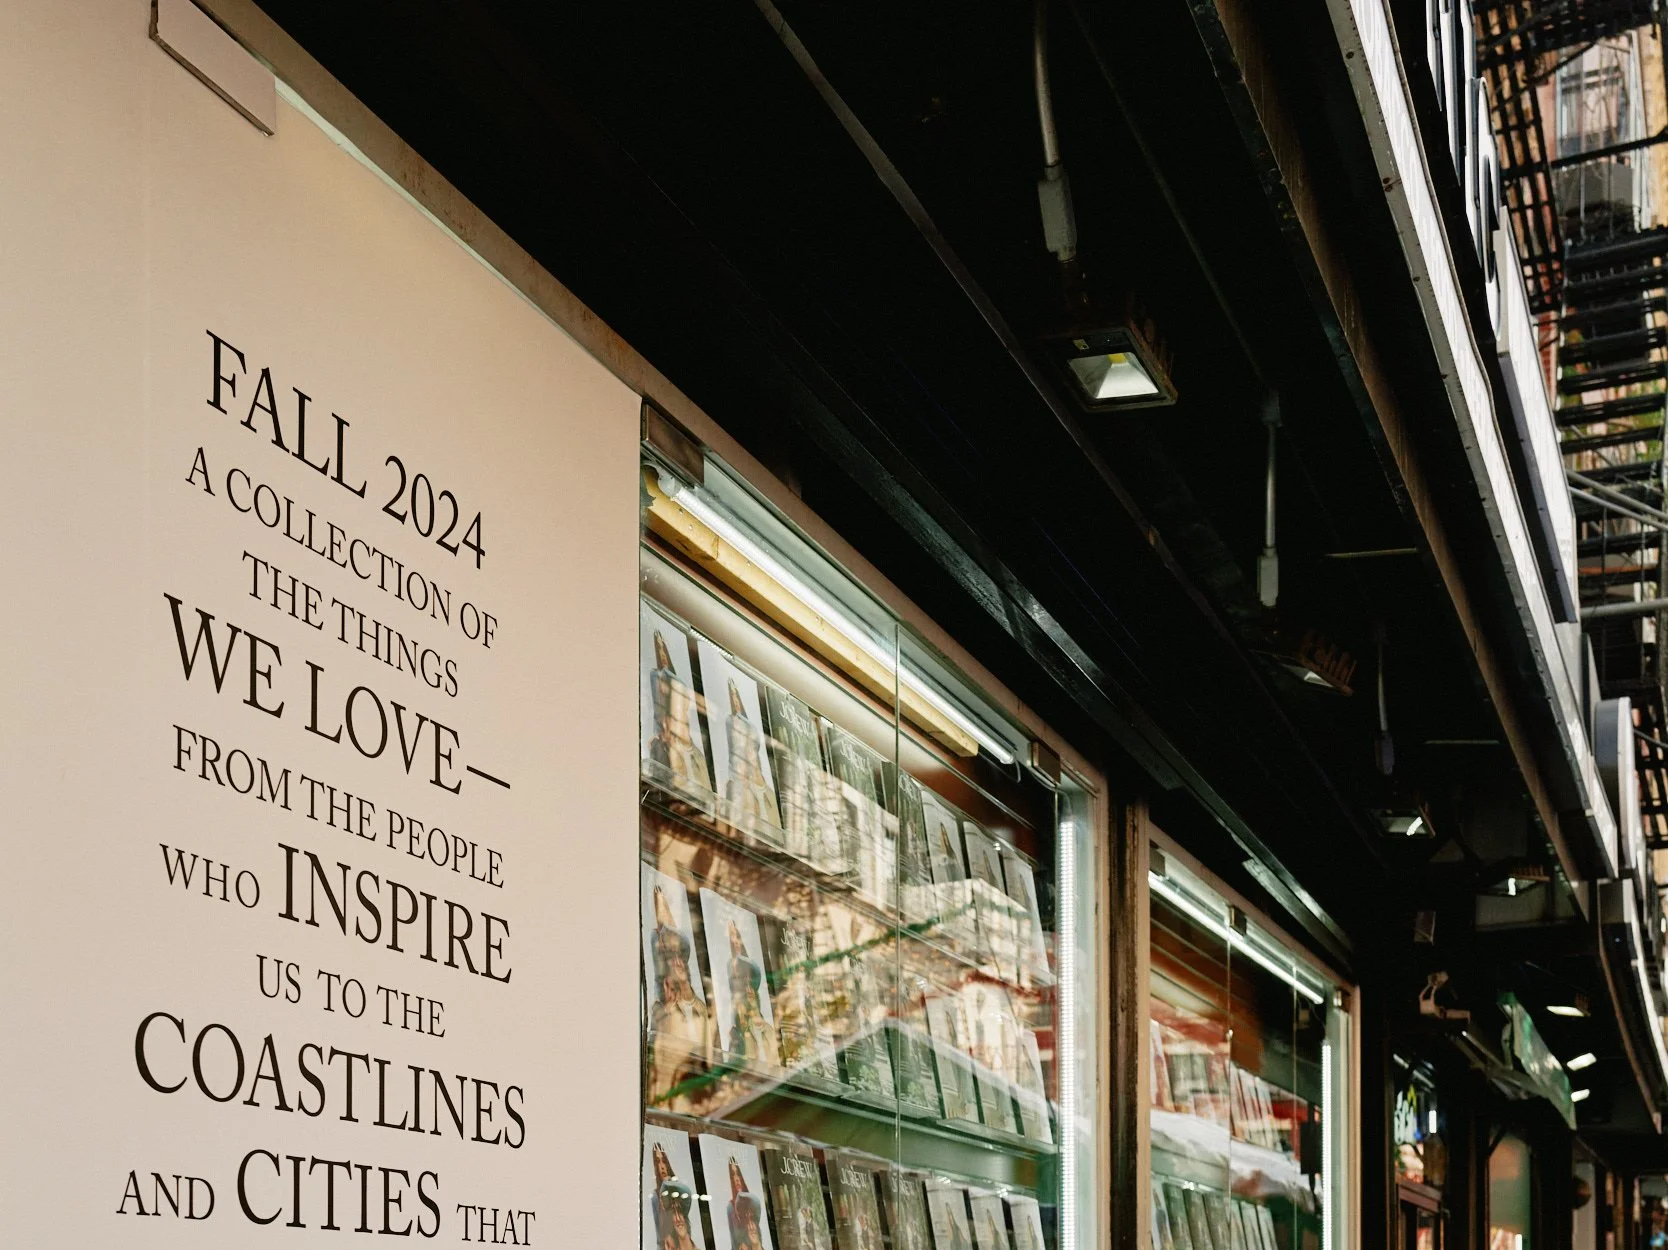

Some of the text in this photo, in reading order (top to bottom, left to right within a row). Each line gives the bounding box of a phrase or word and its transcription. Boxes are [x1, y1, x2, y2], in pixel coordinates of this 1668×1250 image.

[205, 329, 486, 570] FALL 2024
[184, 446, 498, 649] A COLLECTION OF
[163, 592, 285, 719] WE
[241, 549, 458, 698] THE THINGS
[172, 724, 504, 889] FROM THE PEOPLE
[159, 842, 512, 984] WHO INSPIRE
[255, 953, 446, 1038] US TO THE
[134, 1011, 526, 1150] COASTLINES
[115, 1148, 536, 1247] AND CITIES THAT
